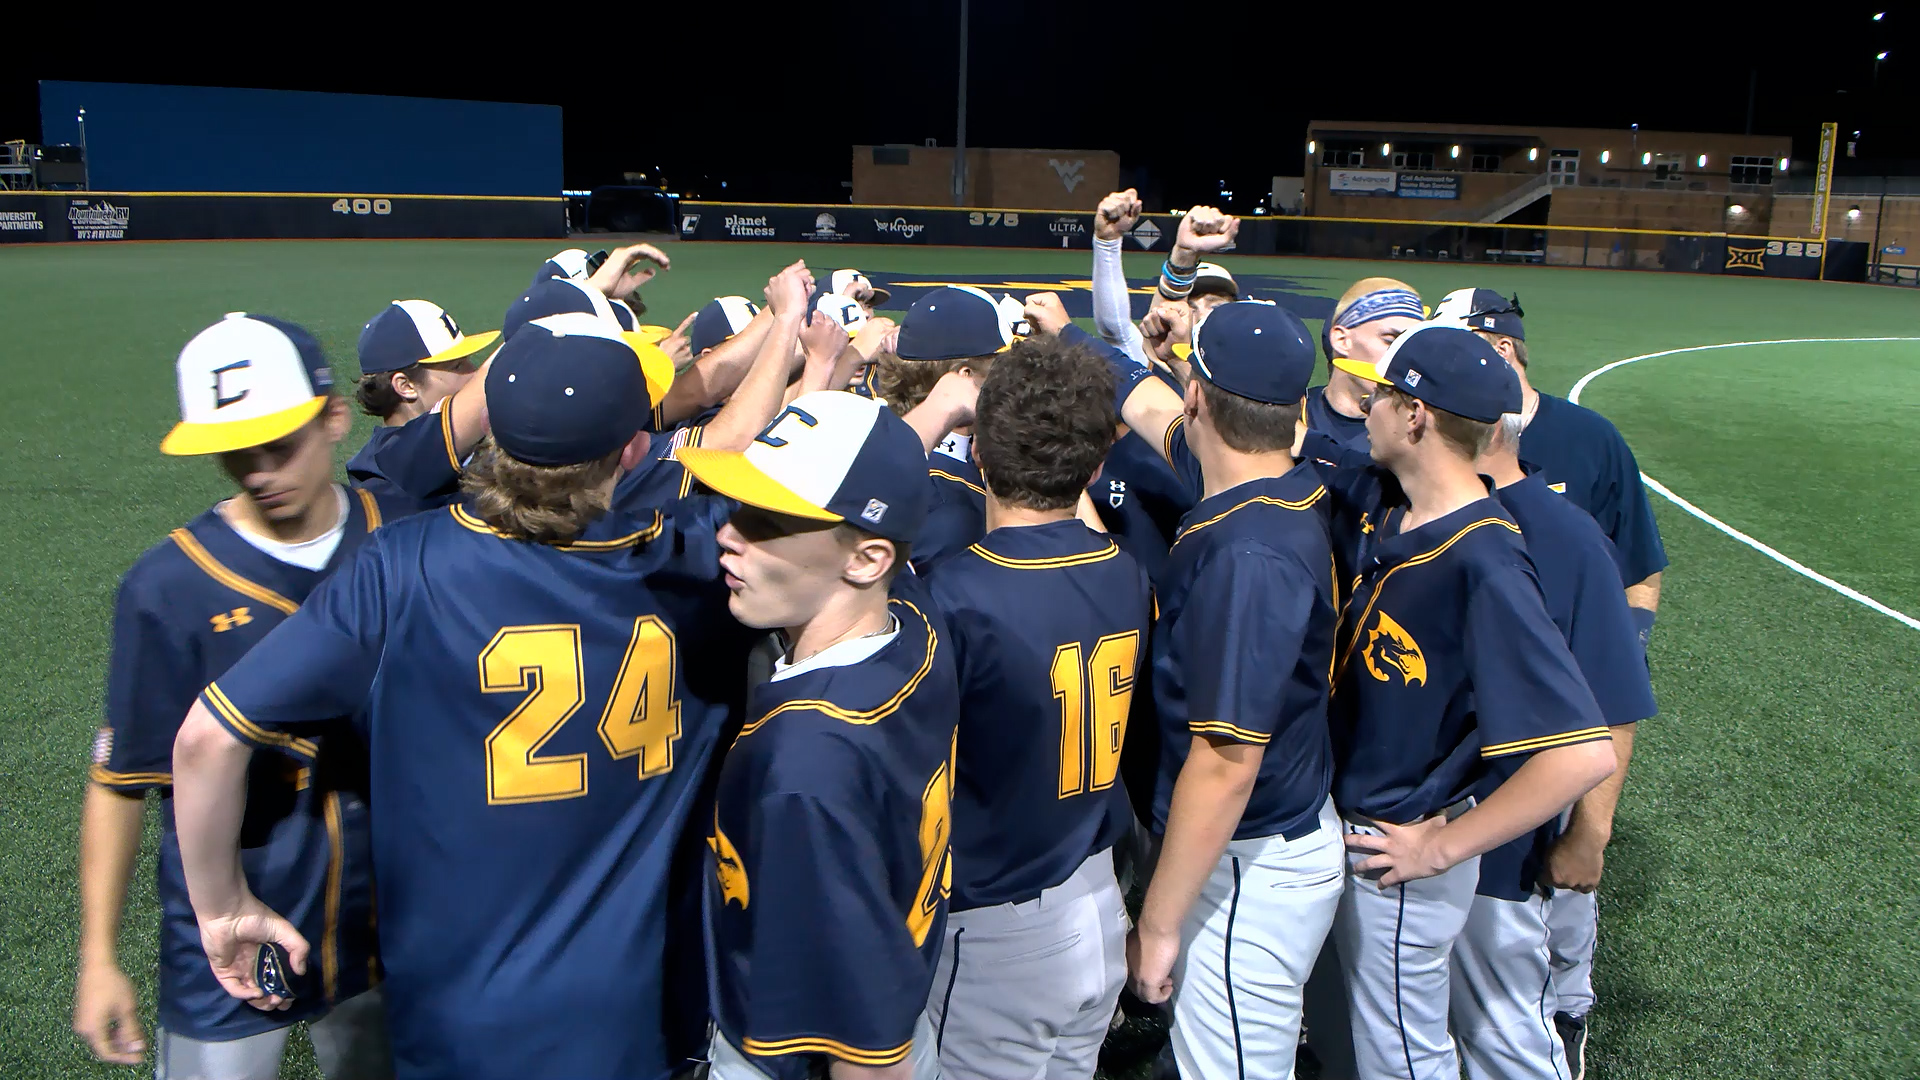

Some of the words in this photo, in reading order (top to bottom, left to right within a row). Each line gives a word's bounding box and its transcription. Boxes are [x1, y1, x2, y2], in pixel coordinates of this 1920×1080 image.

[1352, 175, 1390, 184] Advanced
[68, 206, 115, 220] Mountaineer
[116, 206, 129, 220] RV
[332, 198, 392, 215] 400
[725, 214, 767, 228] planet
[890, 217, 924, 239] Kroger
[969, 212, 1019, 227] 375
[1049, 223, 1085, 233] ULTRA
[105, 229, 124, 239] DEALER
[730, 224, 775, 237] fitness
[1766, 241, 1823, 258] 325
[840, 304, 860, 326] C
[210, 359, 252, 410] C
[754, 404, 818, 448] C
[478, 613, 683, 806] 24
[1049, 629, 1140, 800] 16
[905, 725, 958, 949] 2
